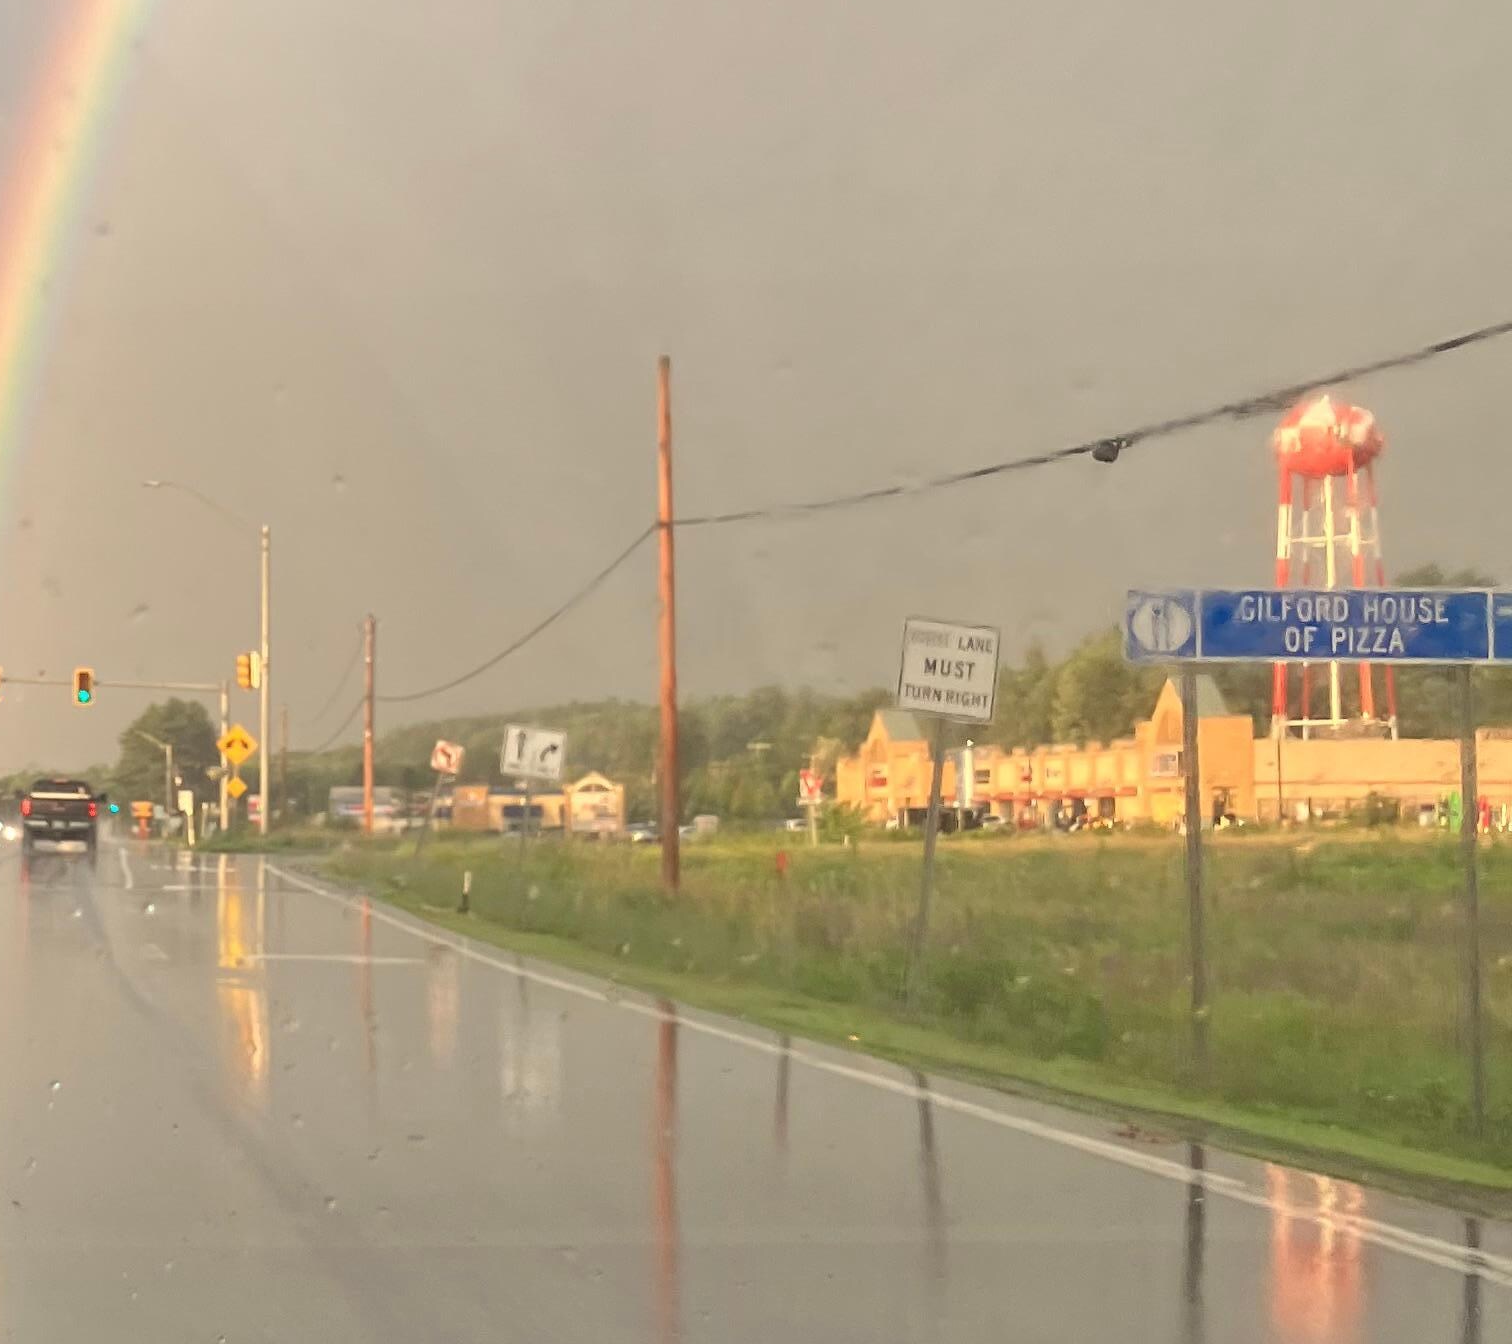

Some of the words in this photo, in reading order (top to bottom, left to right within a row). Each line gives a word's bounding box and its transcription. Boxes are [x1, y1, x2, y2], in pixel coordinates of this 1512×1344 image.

[1239, 594, 1349, 623] GILFORD
[1363, 596, 1449, 624] HOUSE
[957, 635, 993, 655] LANE
[1284, 626, 1318, 653] OF
[1331, 626, 1405, 654] PIZZA
[924, 657, 976, 681] MUST
[903, 682, 942, 703] TURN
[945, 688, 988, 709] RIGHT
